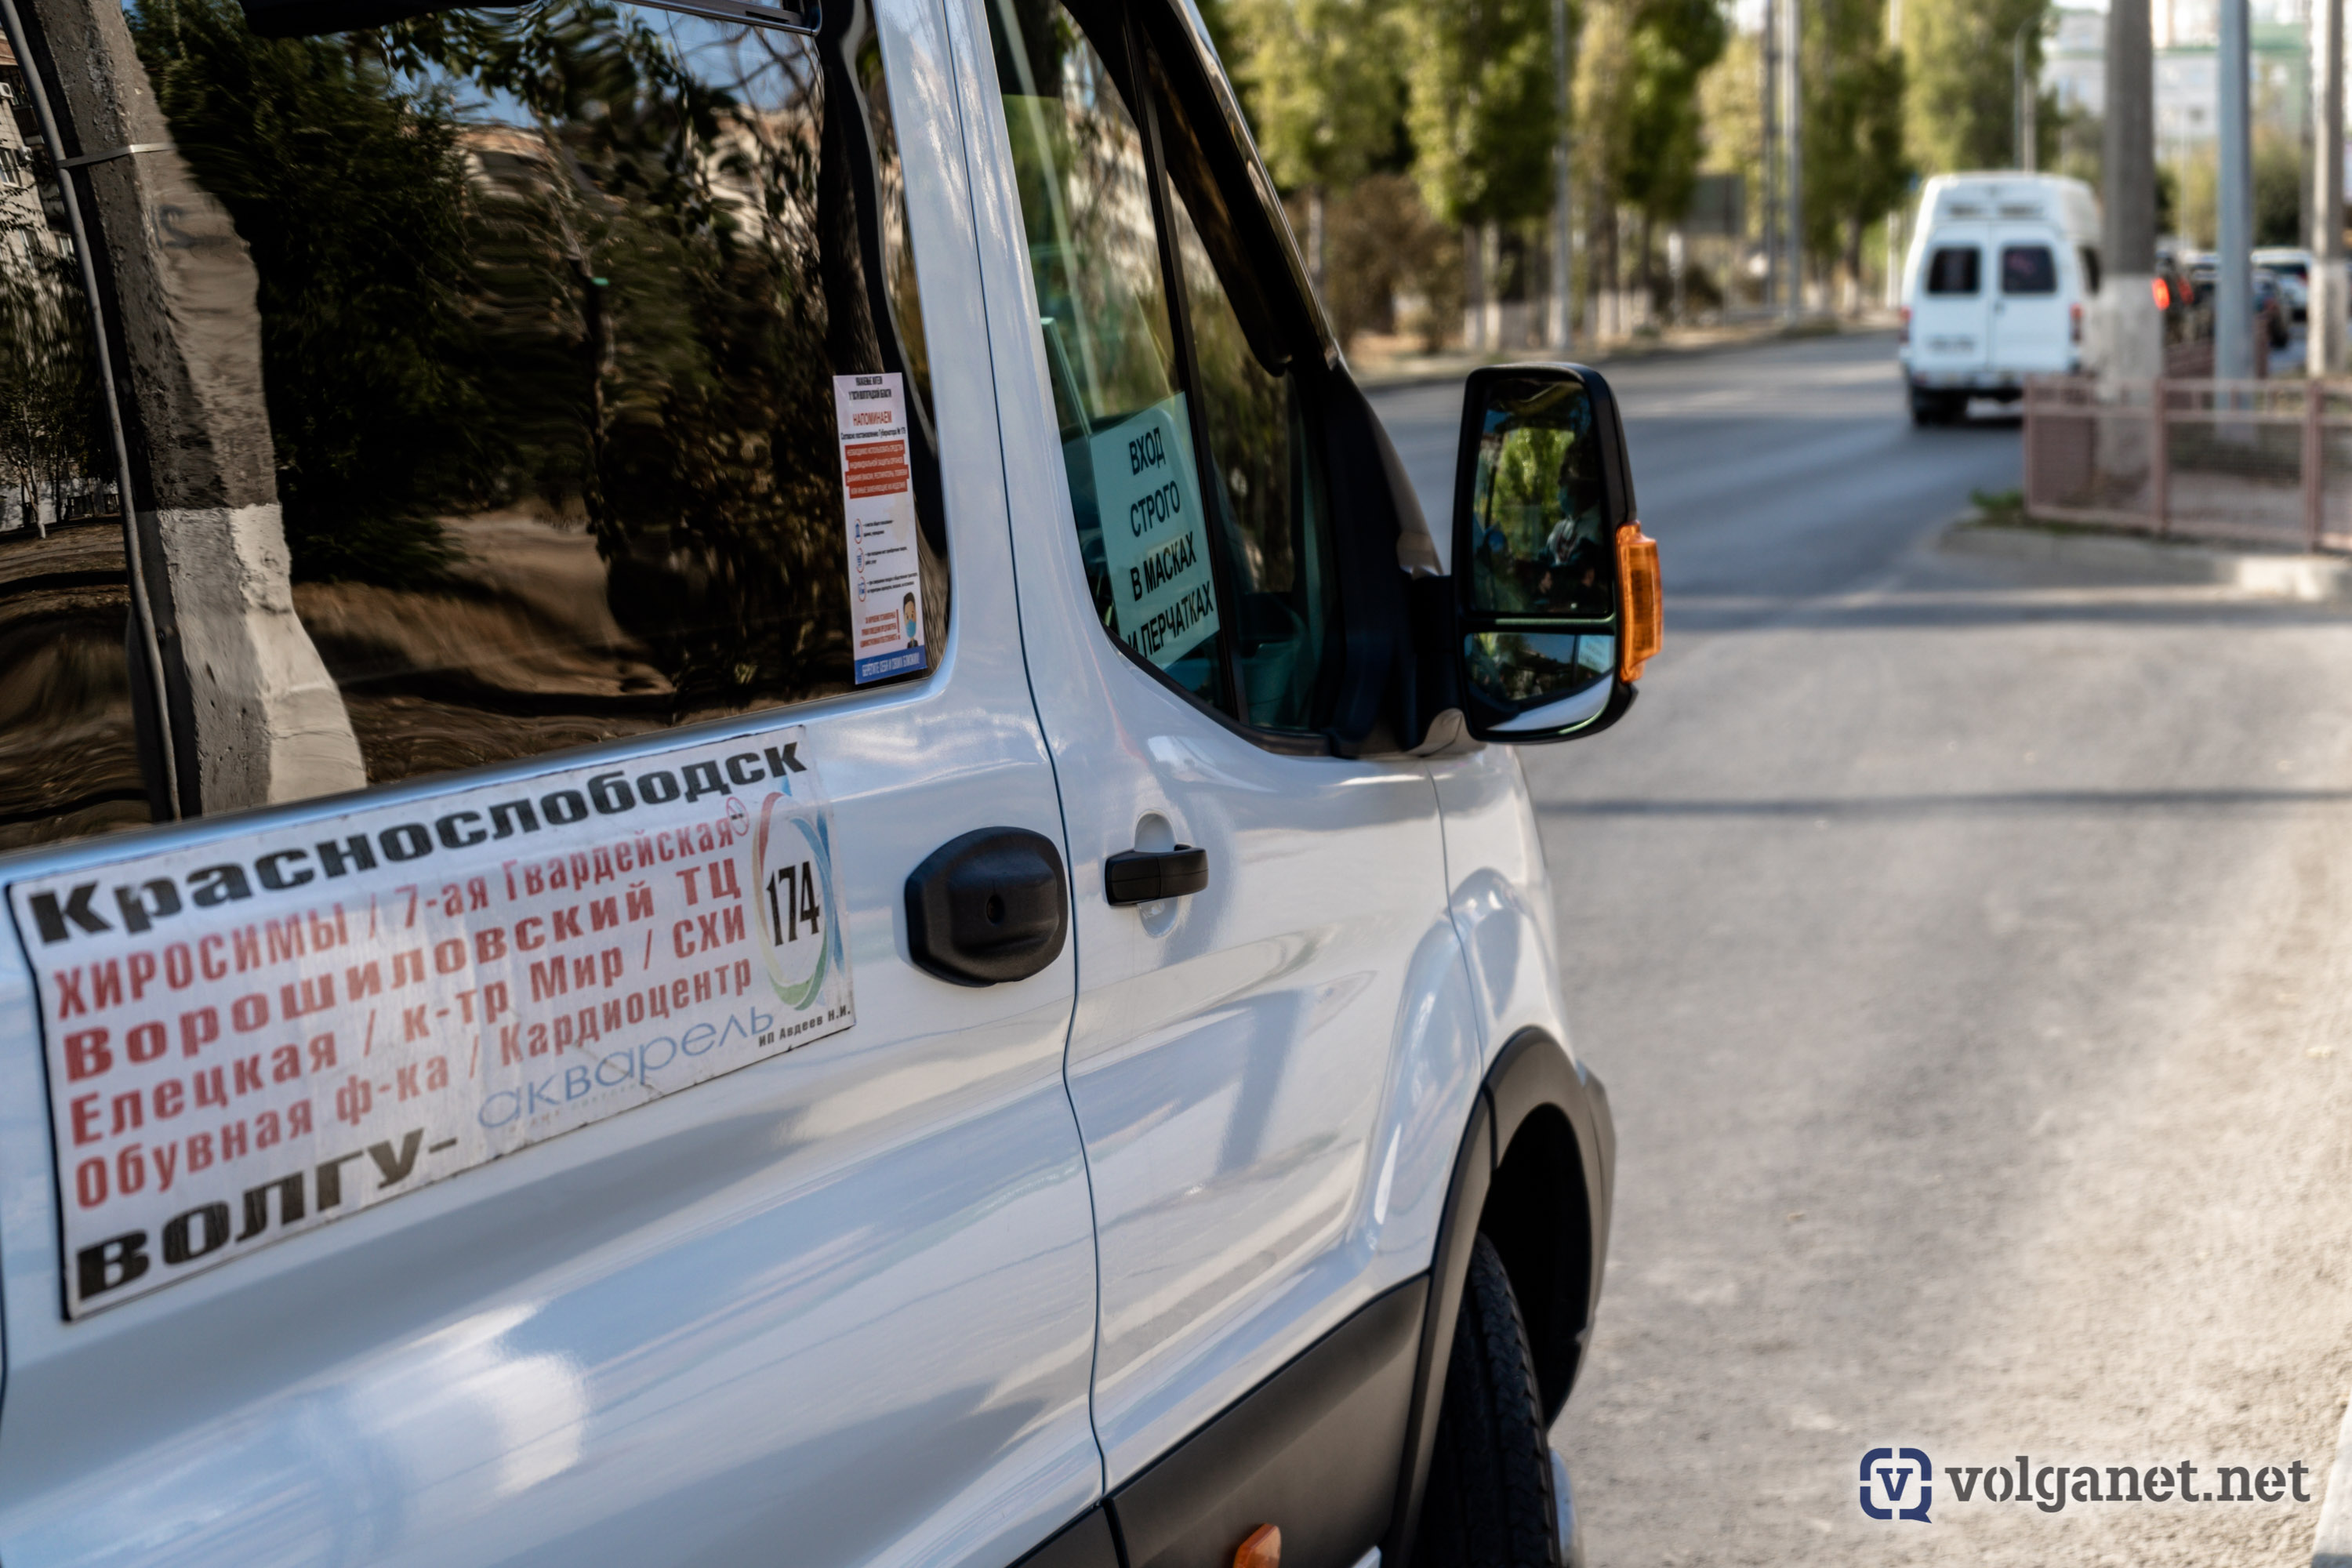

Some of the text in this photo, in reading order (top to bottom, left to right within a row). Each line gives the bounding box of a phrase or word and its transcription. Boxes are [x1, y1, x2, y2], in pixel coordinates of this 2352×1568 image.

[1129, 426, 1165, 475] ВХОД
[1130, 480, 1181, 538] СТРОГО
[1130, 531, 1196, 601] В МАСКАХ
[1141, 580, 1214, 659] ПЕРЧАТКАХ
[27, 742, 808, 946] Краснослободск
[766, 861, 822, 947] 174
[54, 902, 348, 1021] ХИРОСИМЫ
[394, 873, 488, 928] 7-ая
[503, 817, 735, 902] Гвардейская
[64, 858, 742, 1083] Ворошиловский ТЦ
[69, 1031, 337, 1147] Елецкая
[404, 980, 509, 1043] к-тр
[530, 946, 623, 1004] Мир
[673, 905, 746, 960] СХИ
[75, 1099, 313, 1210] Обувная
[336, 1054, 449, 1127] ф-ка
[500, 957, 752, 1066] Кардиоцентр
[758, 1005, 851, 1048] ИП Авдеев Н.И.
[78, 1128, 459, 1301] ВОЛГУ-
